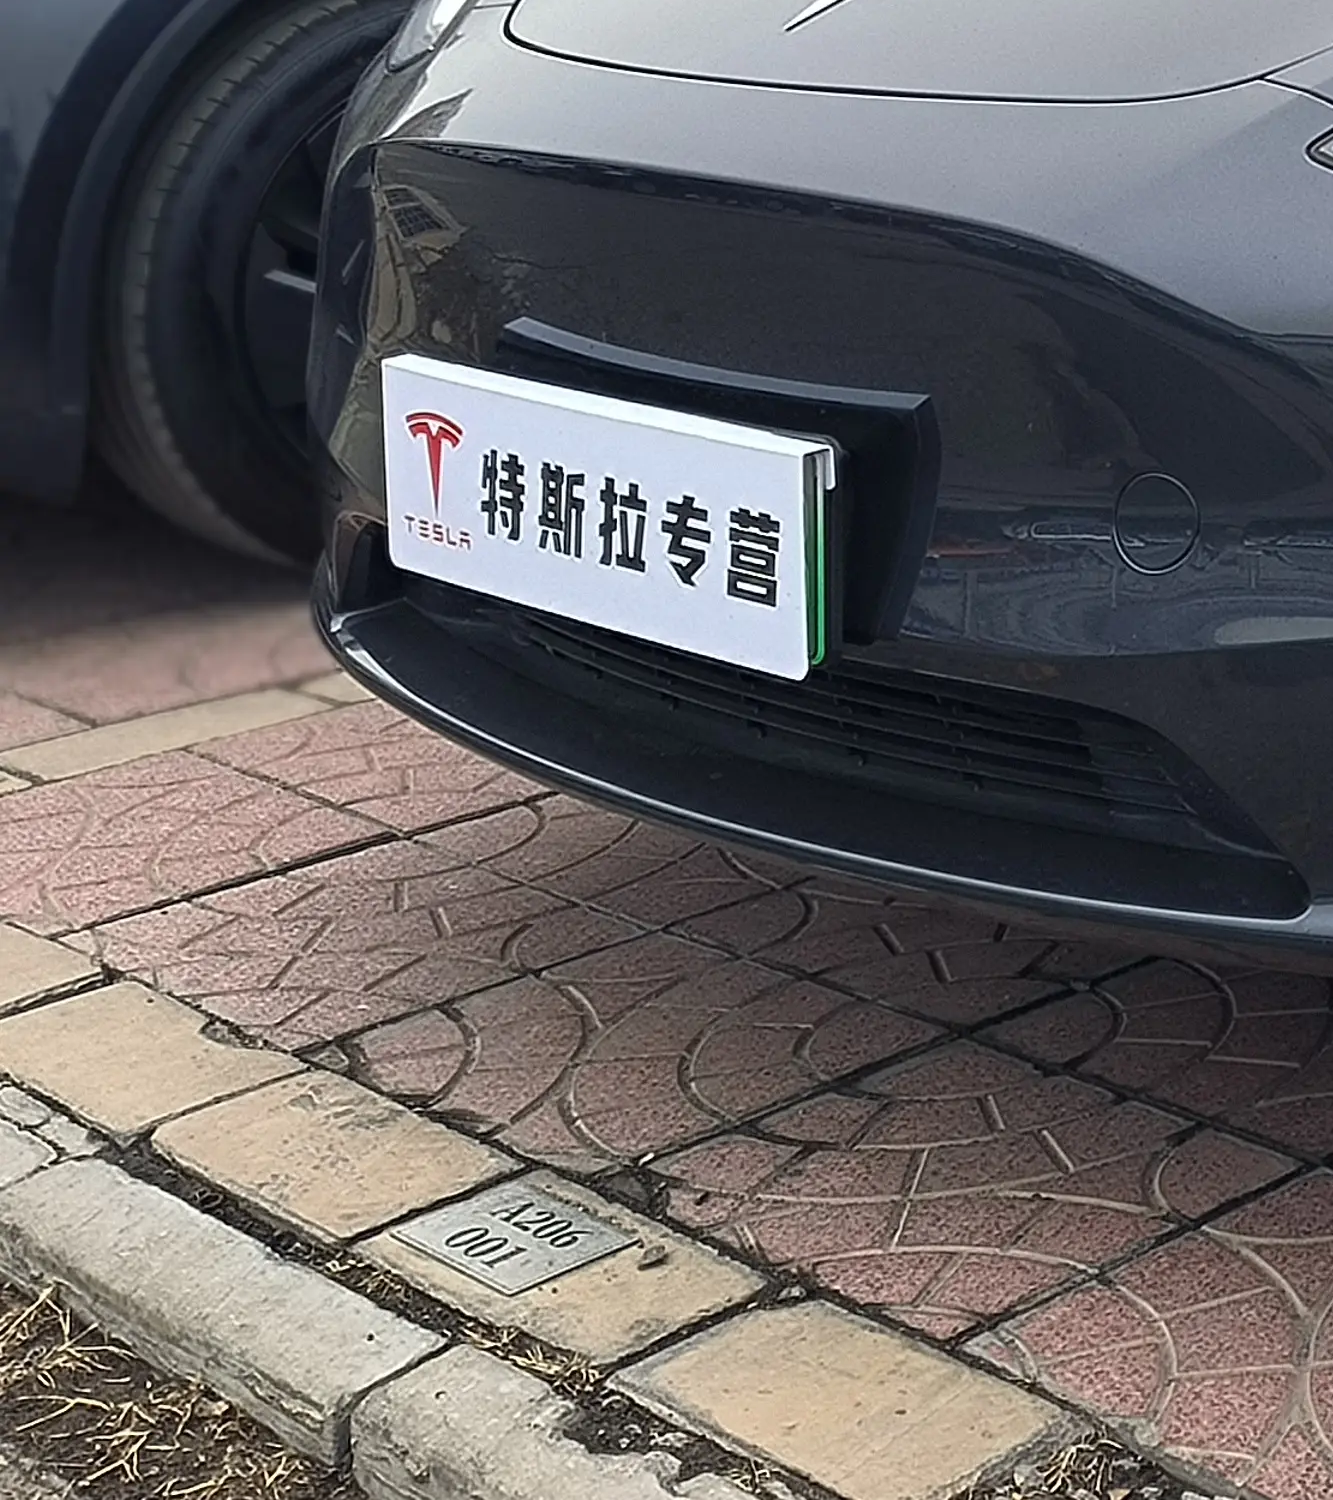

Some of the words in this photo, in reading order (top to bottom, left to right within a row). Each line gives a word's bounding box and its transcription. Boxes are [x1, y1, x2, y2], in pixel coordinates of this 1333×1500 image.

[404, 515, 471, 551] TESLA
[480, 448, 781, 608] 特斯拉专营
[490, 1202, 594, 1248] A206
[445, 1227, 528, 1268] 001
